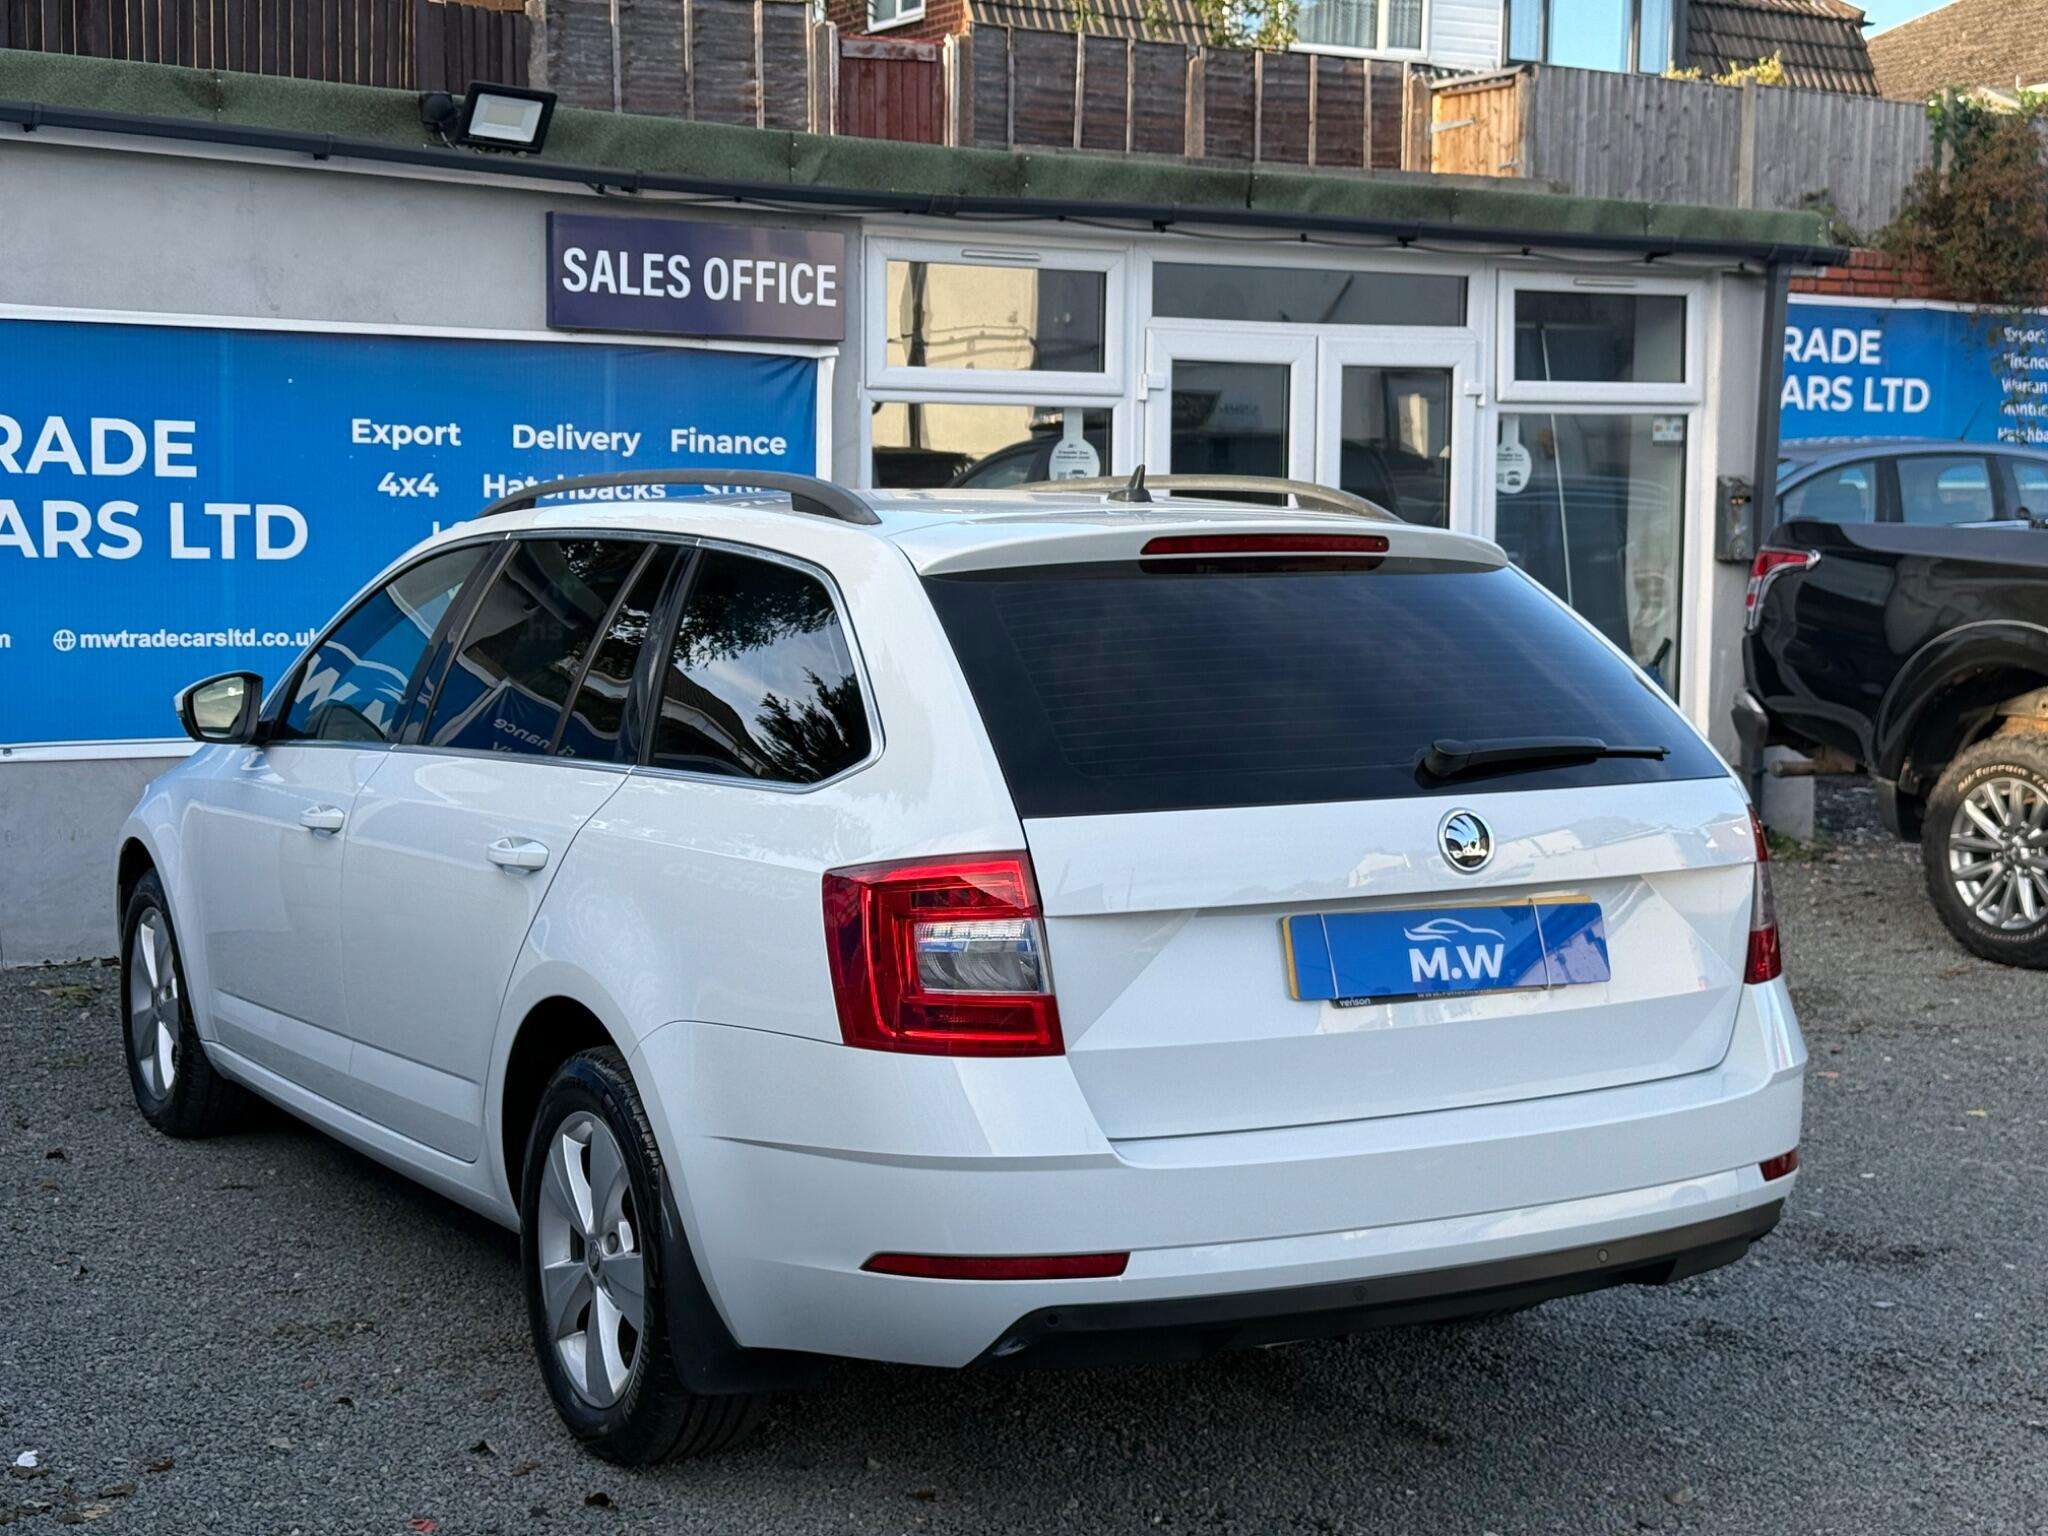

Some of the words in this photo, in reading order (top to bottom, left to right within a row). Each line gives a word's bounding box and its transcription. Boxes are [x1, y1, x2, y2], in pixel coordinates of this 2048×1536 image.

[562, 247, 691, 299] SALES
[703, 257, 837, 307] OFFICE
[1863, 377, 1930, 413] LTD
[351, 418, 461, 450] Export
[513, 423, 641, 457] Delivery
[671, 427, 787, 455] Finance
[377, 472, 439, 497] 4x4
[170, 502, 308, 560] LTD
[1408, 943, 1505, 983] M.W
